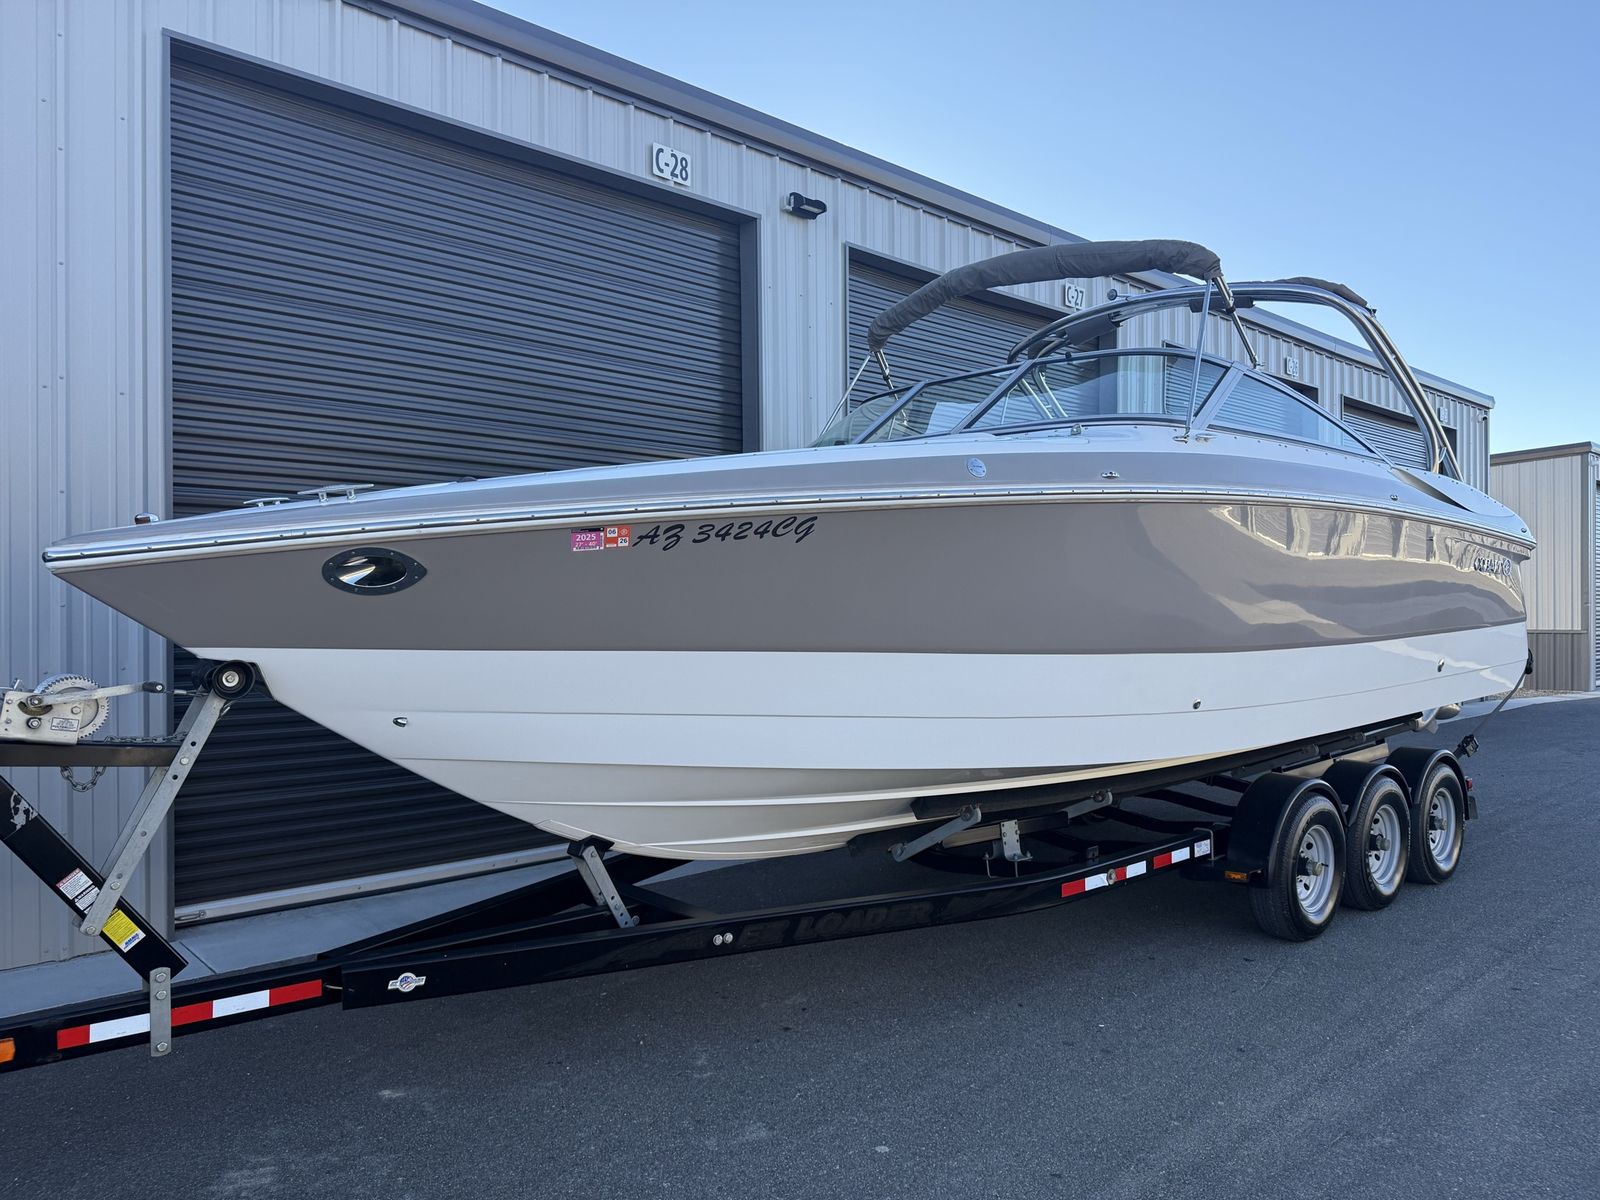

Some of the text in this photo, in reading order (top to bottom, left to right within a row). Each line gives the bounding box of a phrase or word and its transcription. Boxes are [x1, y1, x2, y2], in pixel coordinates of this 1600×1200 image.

[655, 147, 689, 182] C-28
[1066, 285, 1084, 308] C-27
[576, 533, 597, 541] 2025
[632, 515, 818, 551] AZ 3424CG
[795, 902, 931, 940] LOADER
